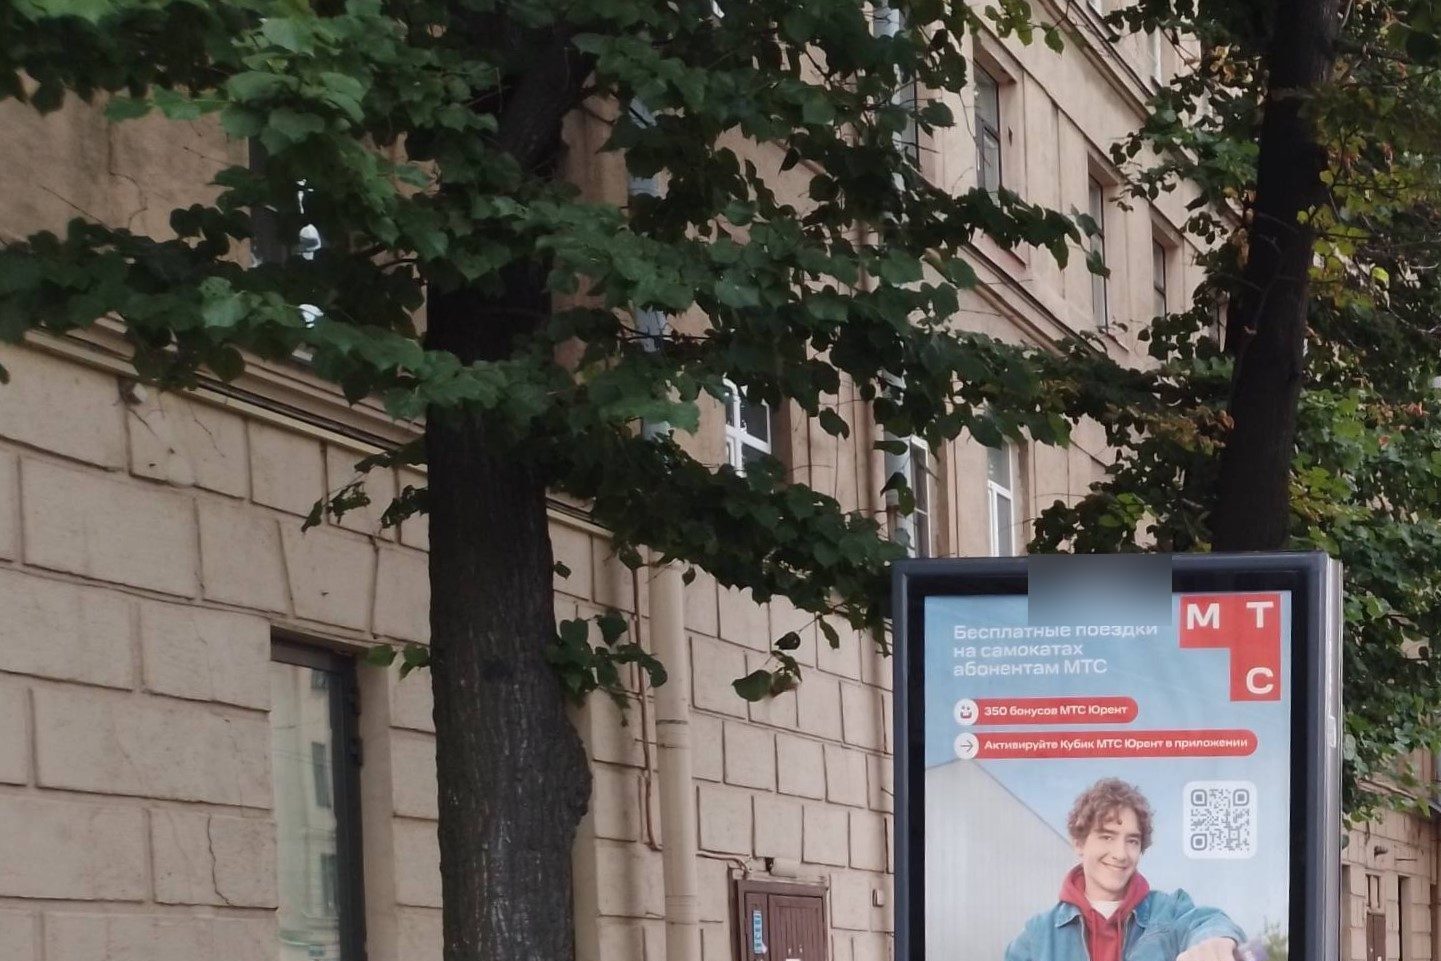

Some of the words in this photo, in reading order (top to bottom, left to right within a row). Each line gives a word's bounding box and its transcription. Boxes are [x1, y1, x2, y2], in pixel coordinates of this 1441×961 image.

[953, 625, 1072, 640] Бесплатные
[1076, 624, 1158, 638] поездки
[953, 645, 977, 658] на
[981, 643, 1083, 658] самокатах
[953, 661, 1059, 677] абонентам
[1064, 659, 1108, 674] МТС
[984, 706, 1008, 716] 350
[1009, 705, 1058, 719] бонусов
[1060, 705, 1087, 715] МТС
[1088, 704, 1128, 717] Юрент
[984, 739, 1058, 753] Активируйте
[1060, 739, 1094, 753] Кубик
[1096, 739, 1123, 749] МТС
[1125, 738, 1163, 750] Юрент
[1165, 740, 1173, 748] в
[1174, 739, 1248, 750] приложении
